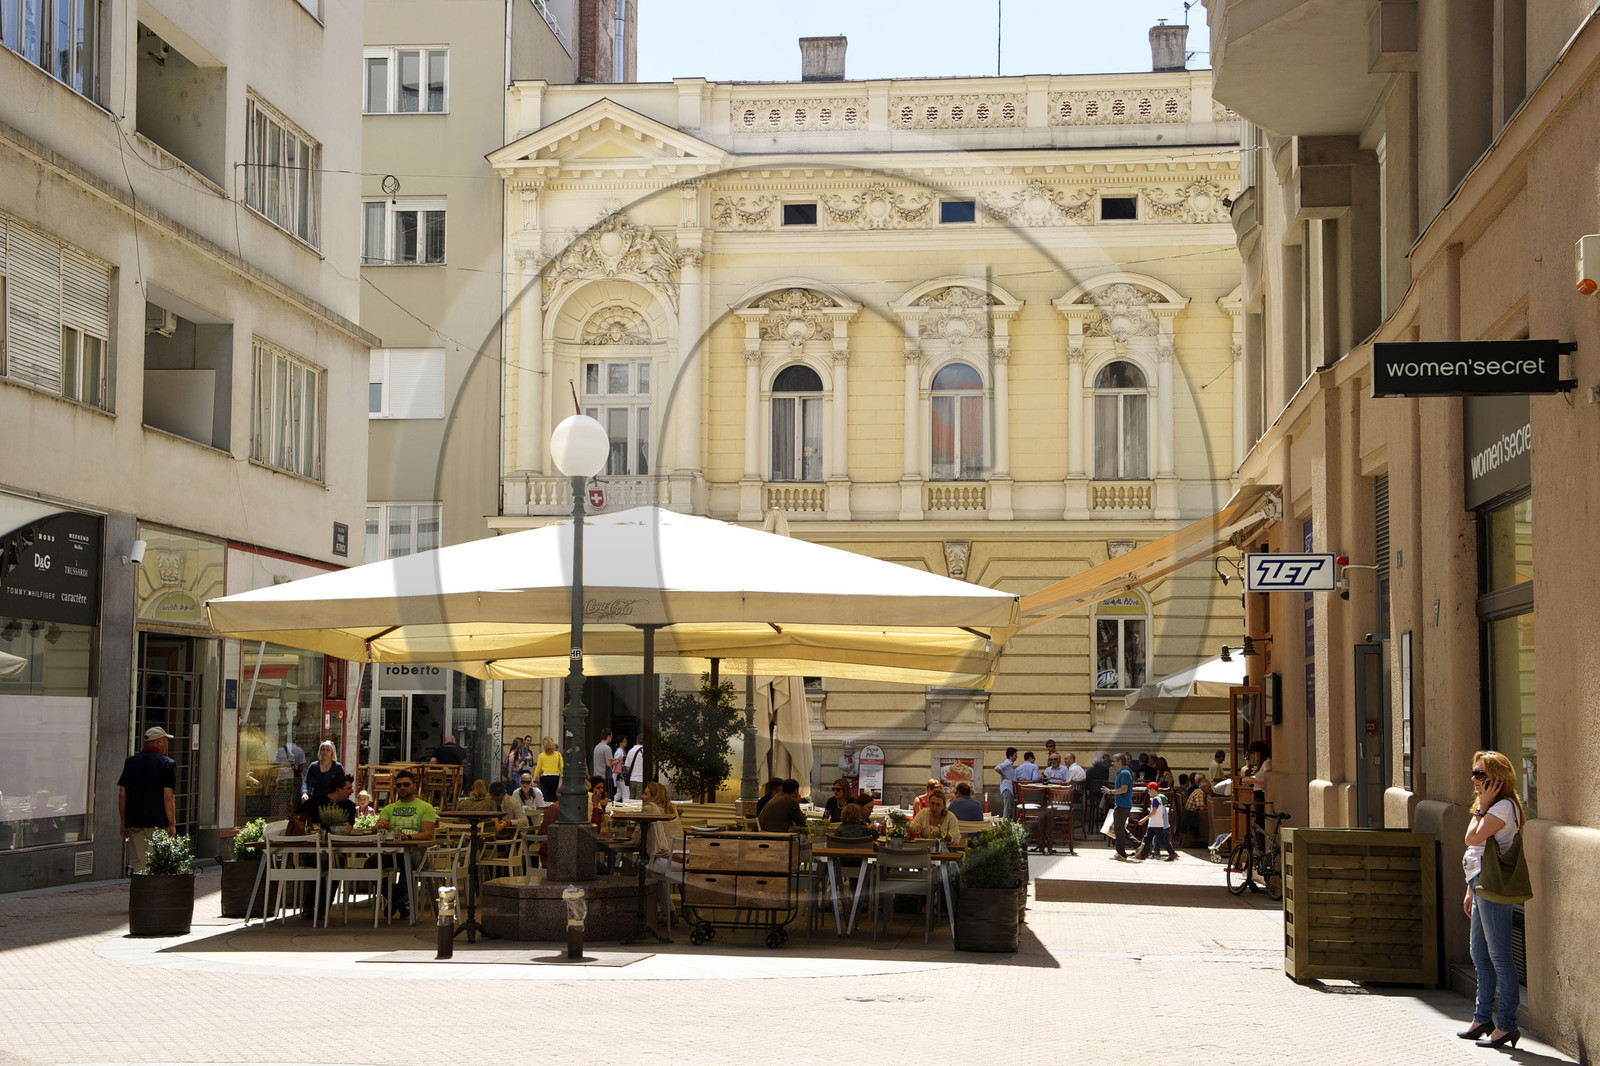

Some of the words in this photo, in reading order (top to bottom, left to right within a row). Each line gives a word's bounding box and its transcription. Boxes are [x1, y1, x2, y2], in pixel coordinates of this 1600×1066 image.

[1386, 358, 1545, 377] women'secret
[1471, 423, 1531, 480] women'secre
[34, 552, 51, 569] D&G
[1256, 559, 1326, 586] ZET
[6, 586, 27, 596] TOMMY
[31, 591, 56, 600] HILFIGER
[386, 665, 440, 675] roberto
